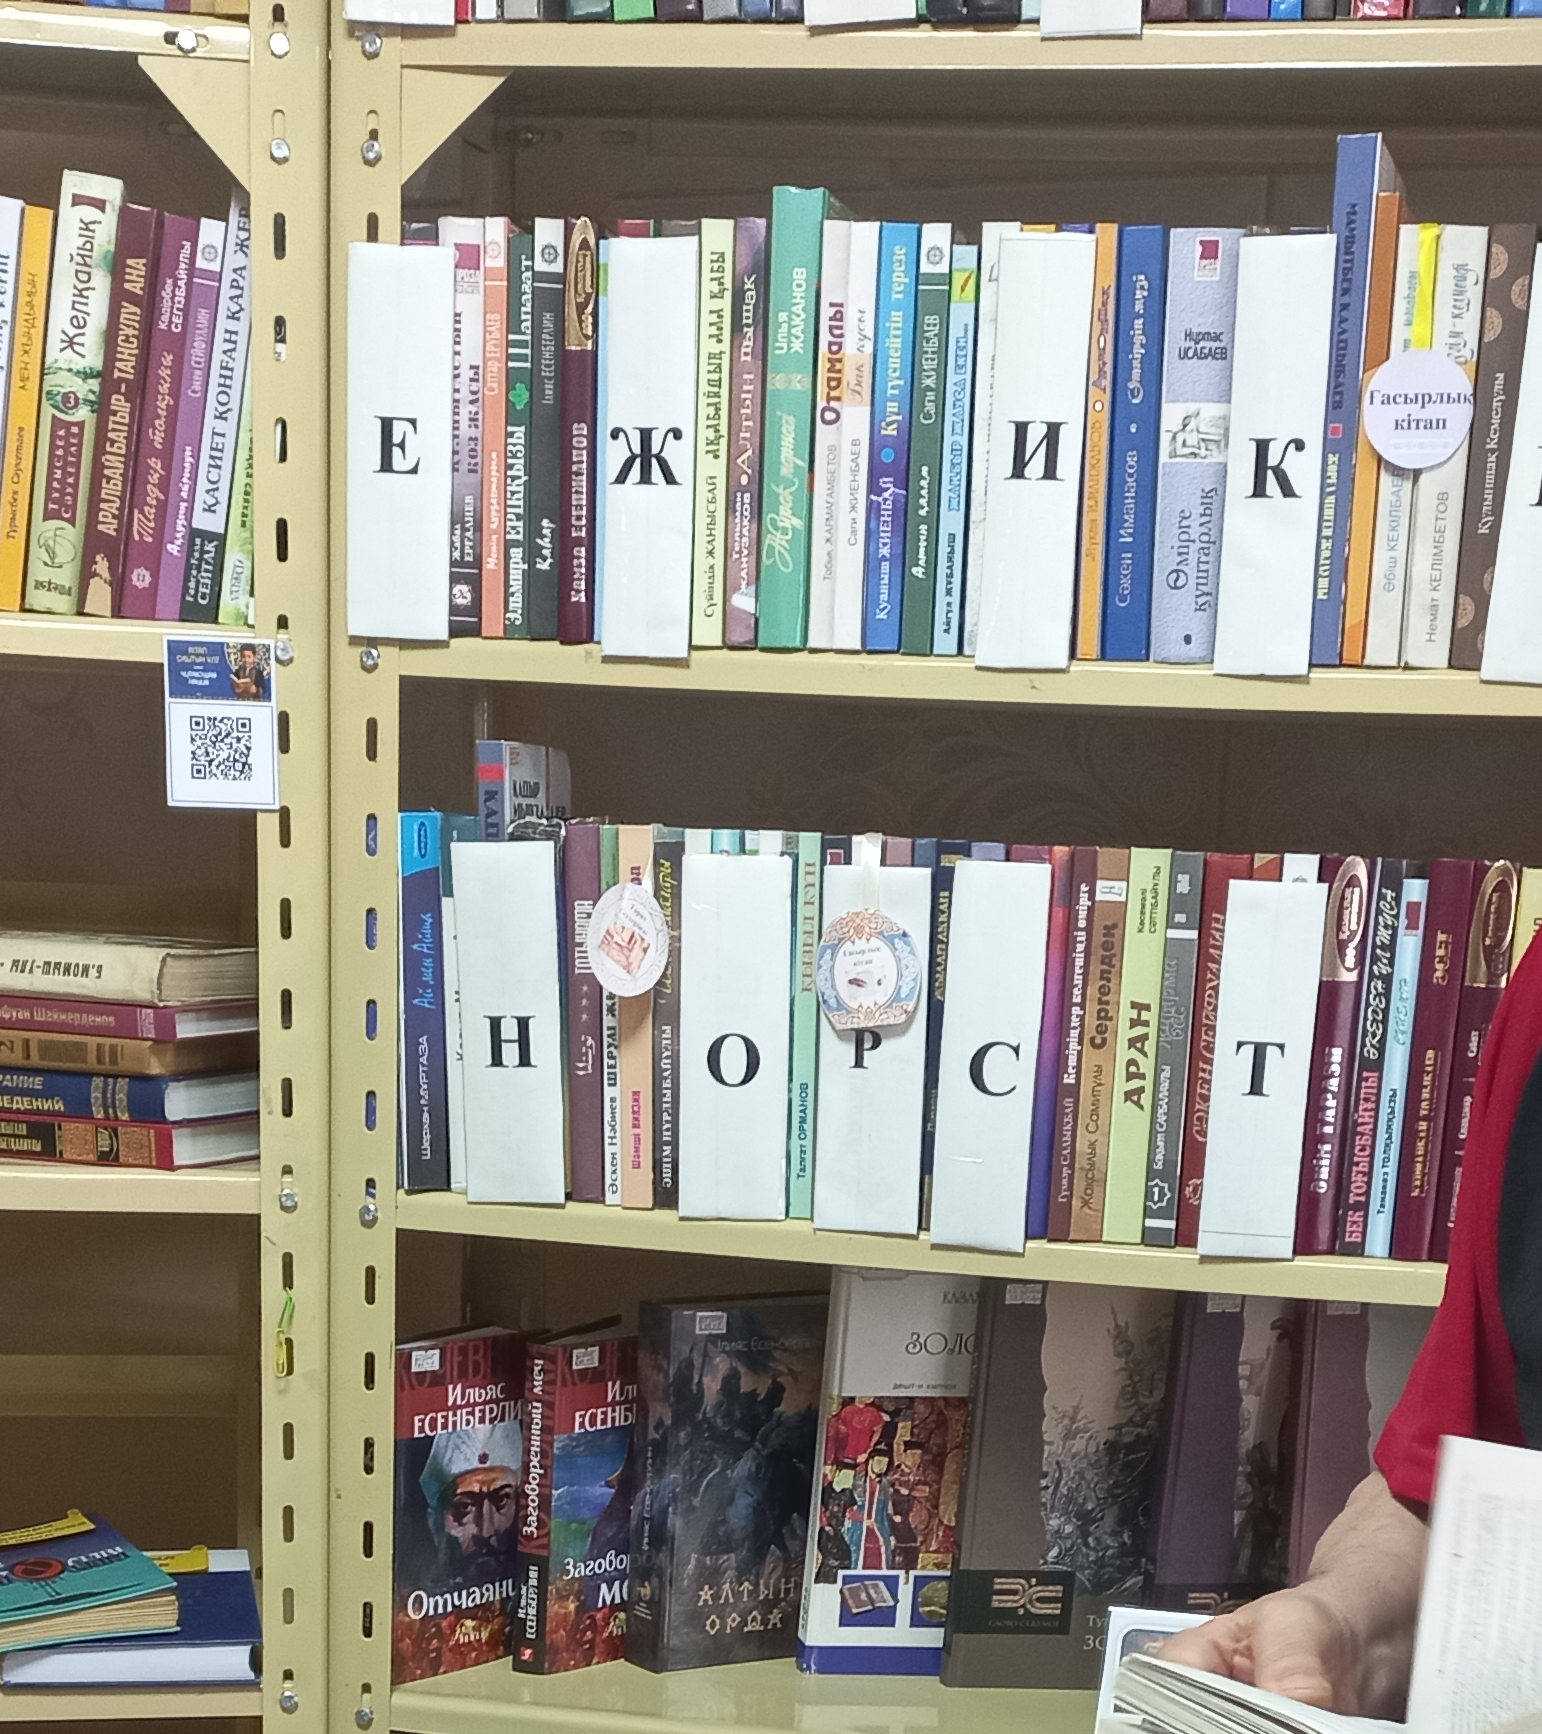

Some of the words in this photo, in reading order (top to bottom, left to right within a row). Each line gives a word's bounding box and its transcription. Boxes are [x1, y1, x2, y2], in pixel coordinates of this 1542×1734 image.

[59, 217, 103, 360] Желқайық
[1178, 345, 1228, 361] ИСАБАЕВ
[1184, 327, 1224, 345] Нұртас
[372, 414, 421, 475] Е
[1003, 420, 1069, 482] И
[1393, 414, 1447, 433] кітап
[609, 426, 683, 486] Ж
[1245, 437, 1306, 500] К
[506, 547, 524, 626] Эльмира
[484, 1015, 538, 1069] Н
[707, 1033, 761, 1088] О
[968, 1040, 1021, 1097] С
[1123, 999, 1152, 1112] АРАН
[1235, 1040, 1286, 1098] Т
[798, 1082, 809, 1141] ОРМАНОВ
[448, 1382, 507, 1406] Ильяс
[532, 1358, 544, 1398] меч
[522, 1399, 545, 1539] Заговоренный
[525, 1565, 539, 1640] ЕСЕНБЕРЛИН
